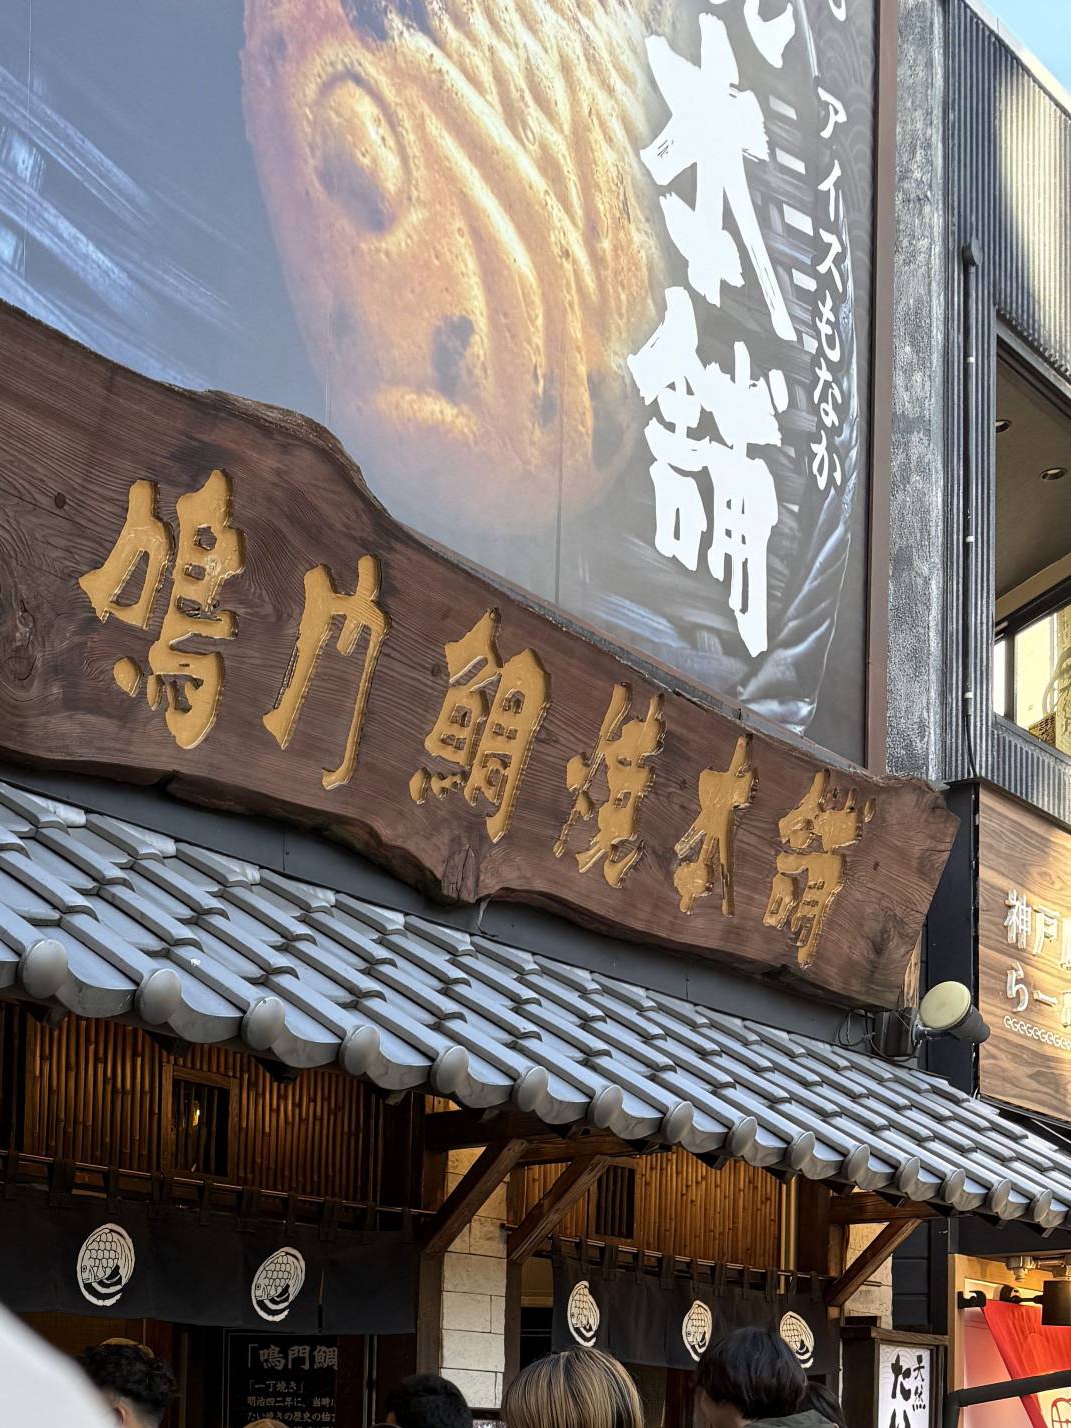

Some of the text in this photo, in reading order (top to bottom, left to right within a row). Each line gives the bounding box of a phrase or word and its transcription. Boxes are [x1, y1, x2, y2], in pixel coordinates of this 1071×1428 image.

[812, 87, 848, 491] アイスもなか
[79, 468, 874, 969] 鳴門鯛焼本舗
[1004, 889, 1071, 968] 神戸
[913, 1354, 926, 1412] 天然
